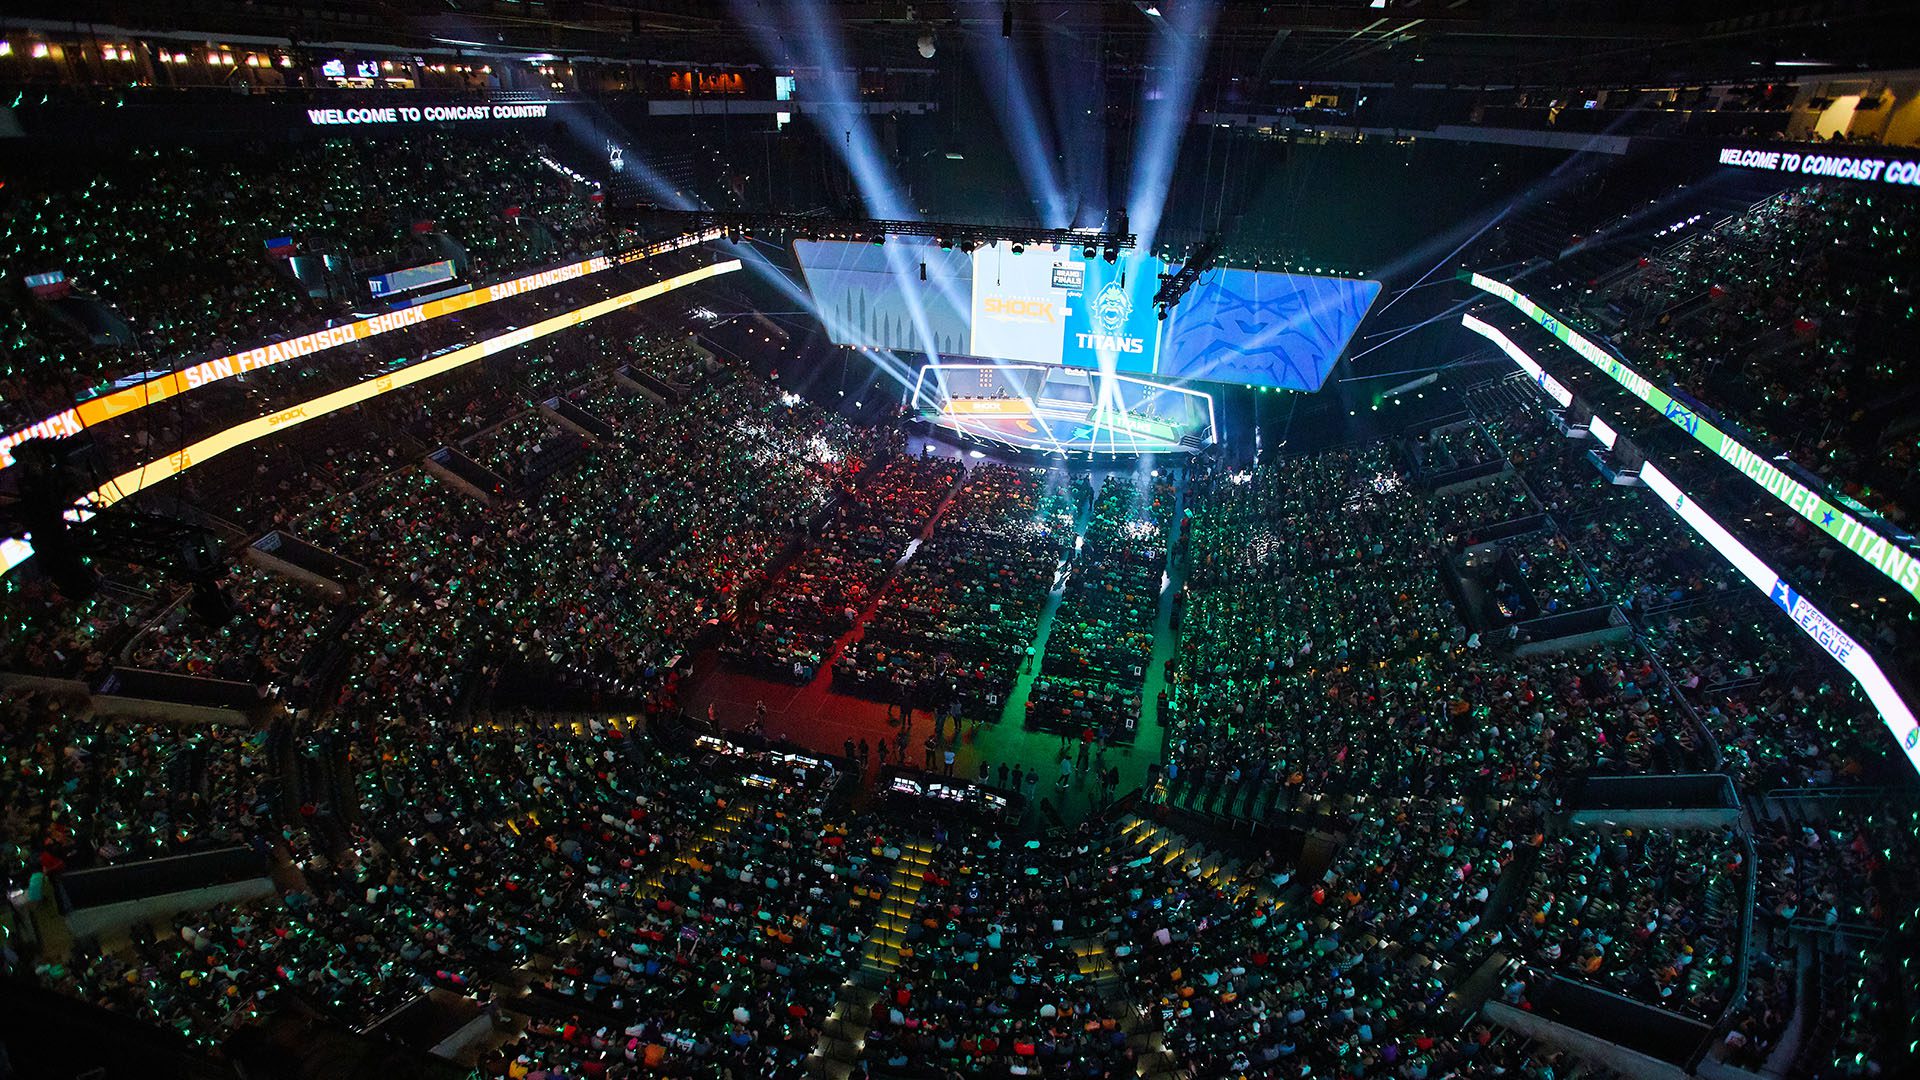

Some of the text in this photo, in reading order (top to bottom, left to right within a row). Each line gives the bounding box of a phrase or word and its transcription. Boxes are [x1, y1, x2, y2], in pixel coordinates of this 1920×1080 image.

[308, 105, 547, 125] WELCOME TO COMCAST COUNTRY
[1719, 148, 1781, 170] WELCOME
[1780, 152, 1801, 172] TO
[1802, 155, 1885, 181] COMCAST
[489, 280, 518, 300] SAN
[519, 262, 583, 294] FRANCISCO
[983, 298, 1056, 324] SHOCK
[184, 305, 427, 389] SAN FRANCISCO SHOCK
[1075, 332, 1143, 353] TITANS
[1617, 363, 1653, 401] TITANS
[269, 407, 307, 426] SHOCK
[1719, 433, 1920, 592] VANCOUVER TITANS
[1793, 610, 1850, 664] LEAGUE
[1797, 597, 1854, 653] OVERWATCH
